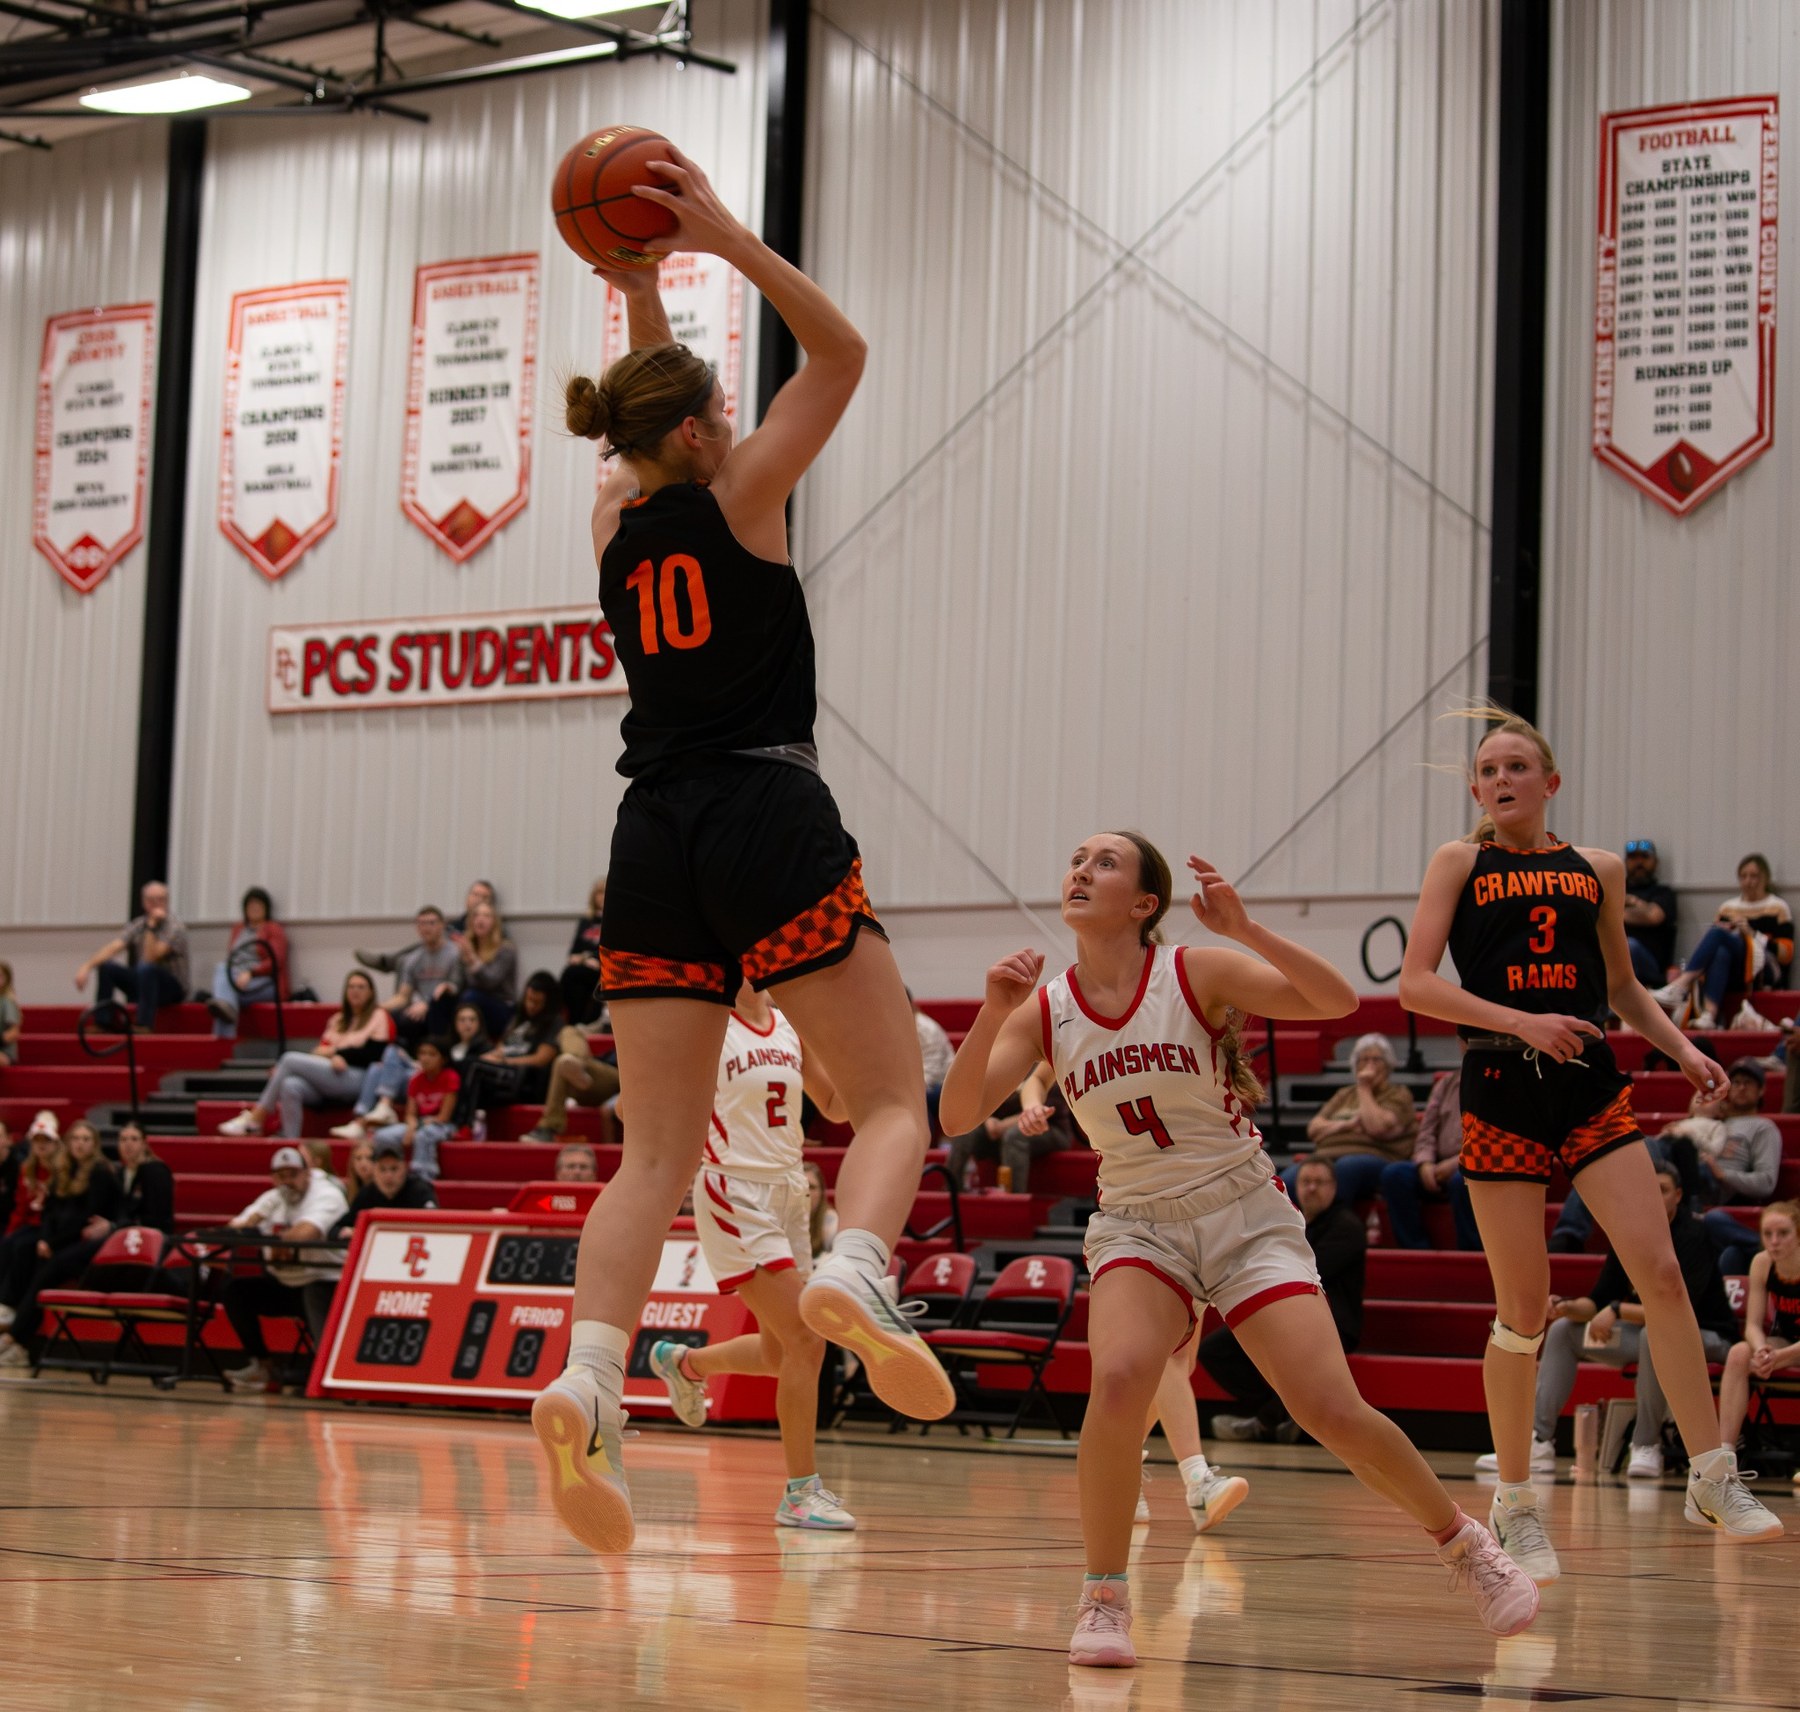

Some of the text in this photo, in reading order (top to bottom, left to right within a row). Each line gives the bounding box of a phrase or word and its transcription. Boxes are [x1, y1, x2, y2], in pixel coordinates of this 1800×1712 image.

[1639, 126, 1736, 152] FOOTBALL
[1662, 155, 1711, 174] STATE
[1635, 358, 1732, 382] RUNNERS UP
[242, 405, 325, 426] CHAMPIONS
[57, 425, 132, 448] CHAMPIONS
[626, 553, 712, 655] 10
[302, 618, 616, 697] PCS STUDENTS
[1474, 871, 1599, 906] CRAWFORD
[1529, 906, 1557, 954] 3
[1507, 963, 1577, 991] RAMS
[1064, 1043, 1201, 1108] PLAINSMEN
[765, 1081, 787, 1128] 2
[1116, 1095, 1175, 1150] 4
[375, 1291, 432, 1317] HOME
[510, 1305, 564, 1328] PERIOD
[640, 1301, 709, 1329] GUEST
